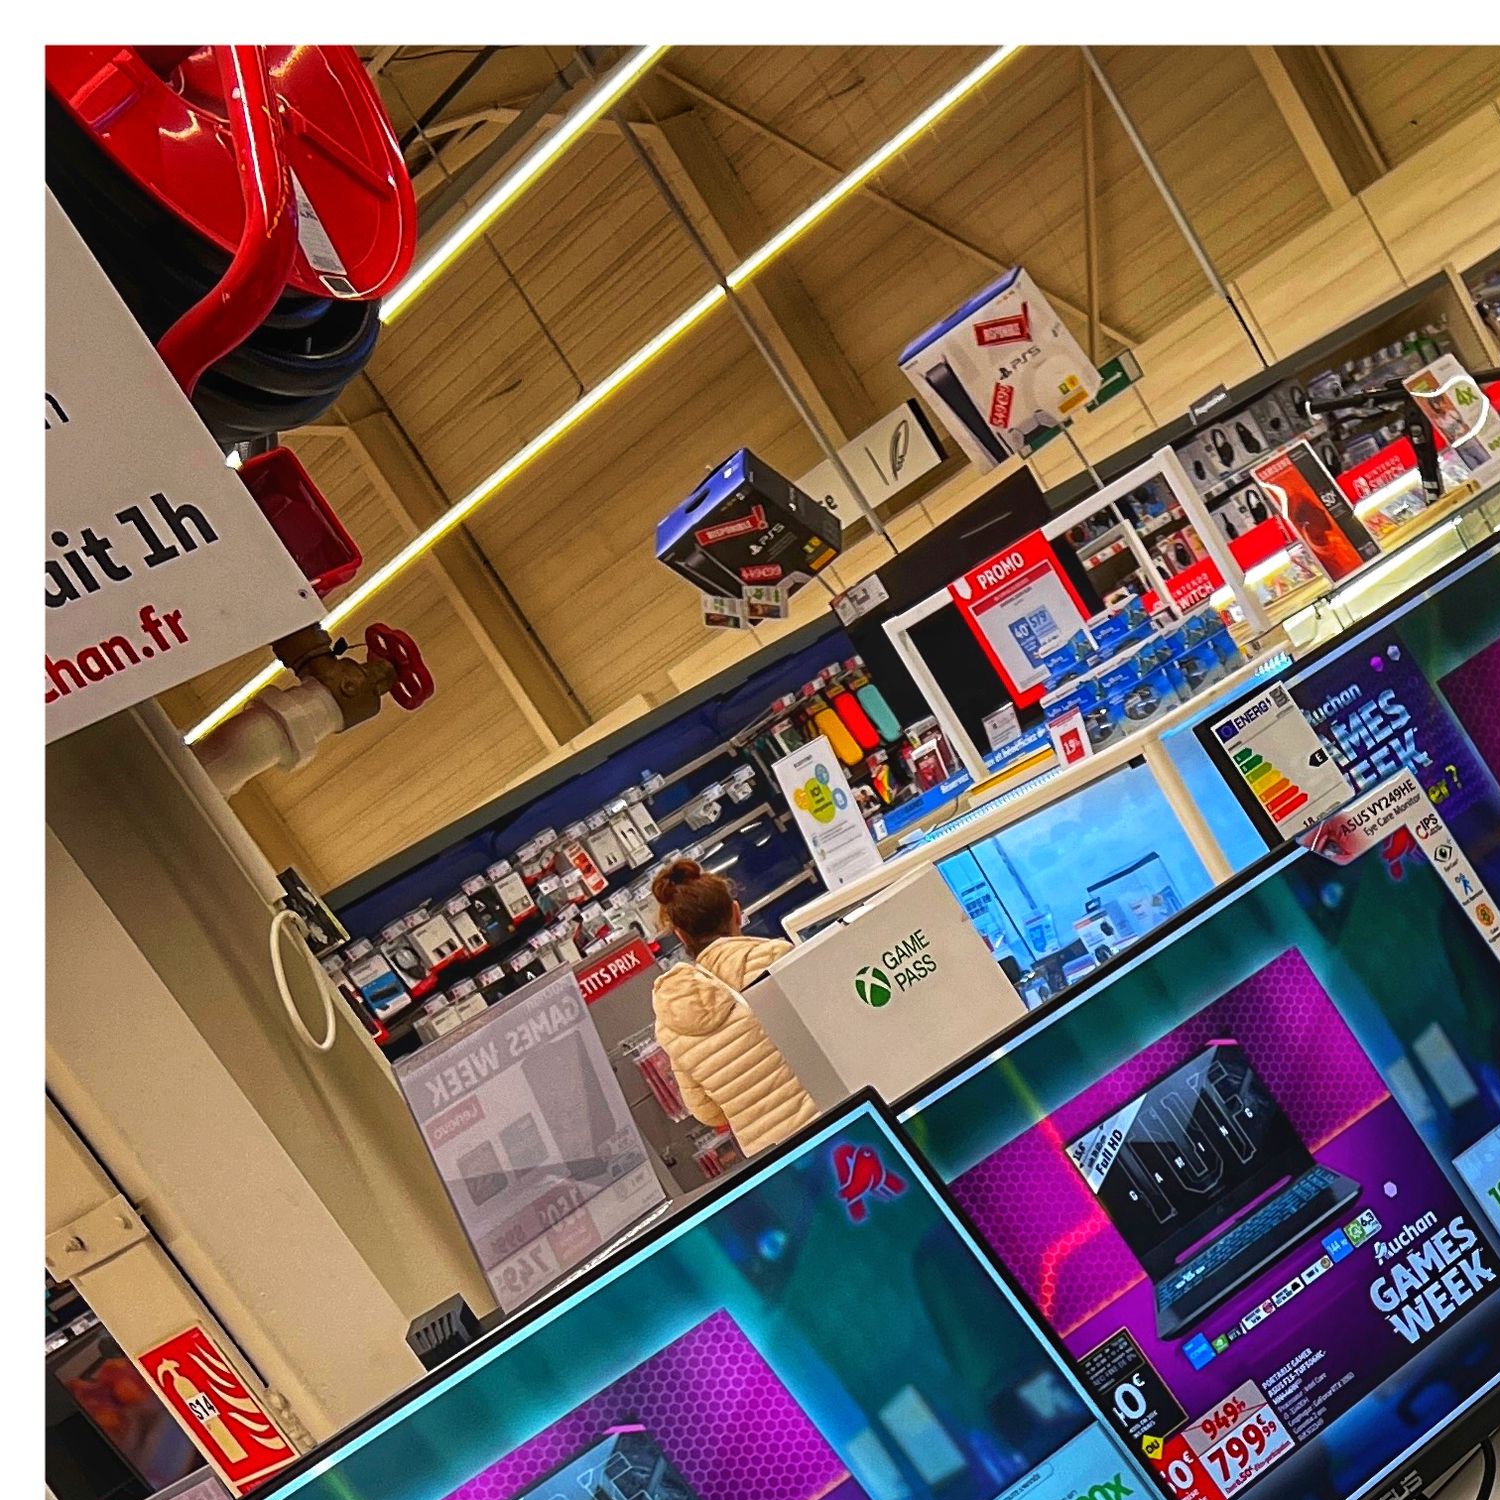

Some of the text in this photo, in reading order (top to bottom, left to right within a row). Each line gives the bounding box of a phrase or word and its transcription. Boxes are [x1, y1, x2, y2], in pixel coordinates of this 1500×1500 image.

[1012, 345, 1041, 370] PS5
[1369, 464, 1406, 490] SWITCH
[114, 492, 219, 569] 1h
[759, 522, 785, 548] PS5
[976, 552, 1024, 591] PROMO
[1319, 688, 1412, 767] AMES
[1341, 809, 1370, 837] ASUS
[1368, 778, 1416, 817] VY249HE
[1363, 793, 1422, 837] Eye Care Monitor
[609, 949, 641, 987] PRIX
[882, 928, 931, 972] GAME
[893, 954, 938, 993] PASS
[1107, 1128, 1124, 1152] HD
[1373, 1210, 1438, 1266] Auchan
[1369, 1215, 1478, 1313] GAMES
[1384, 1247, 1497, 1345] WEEK
